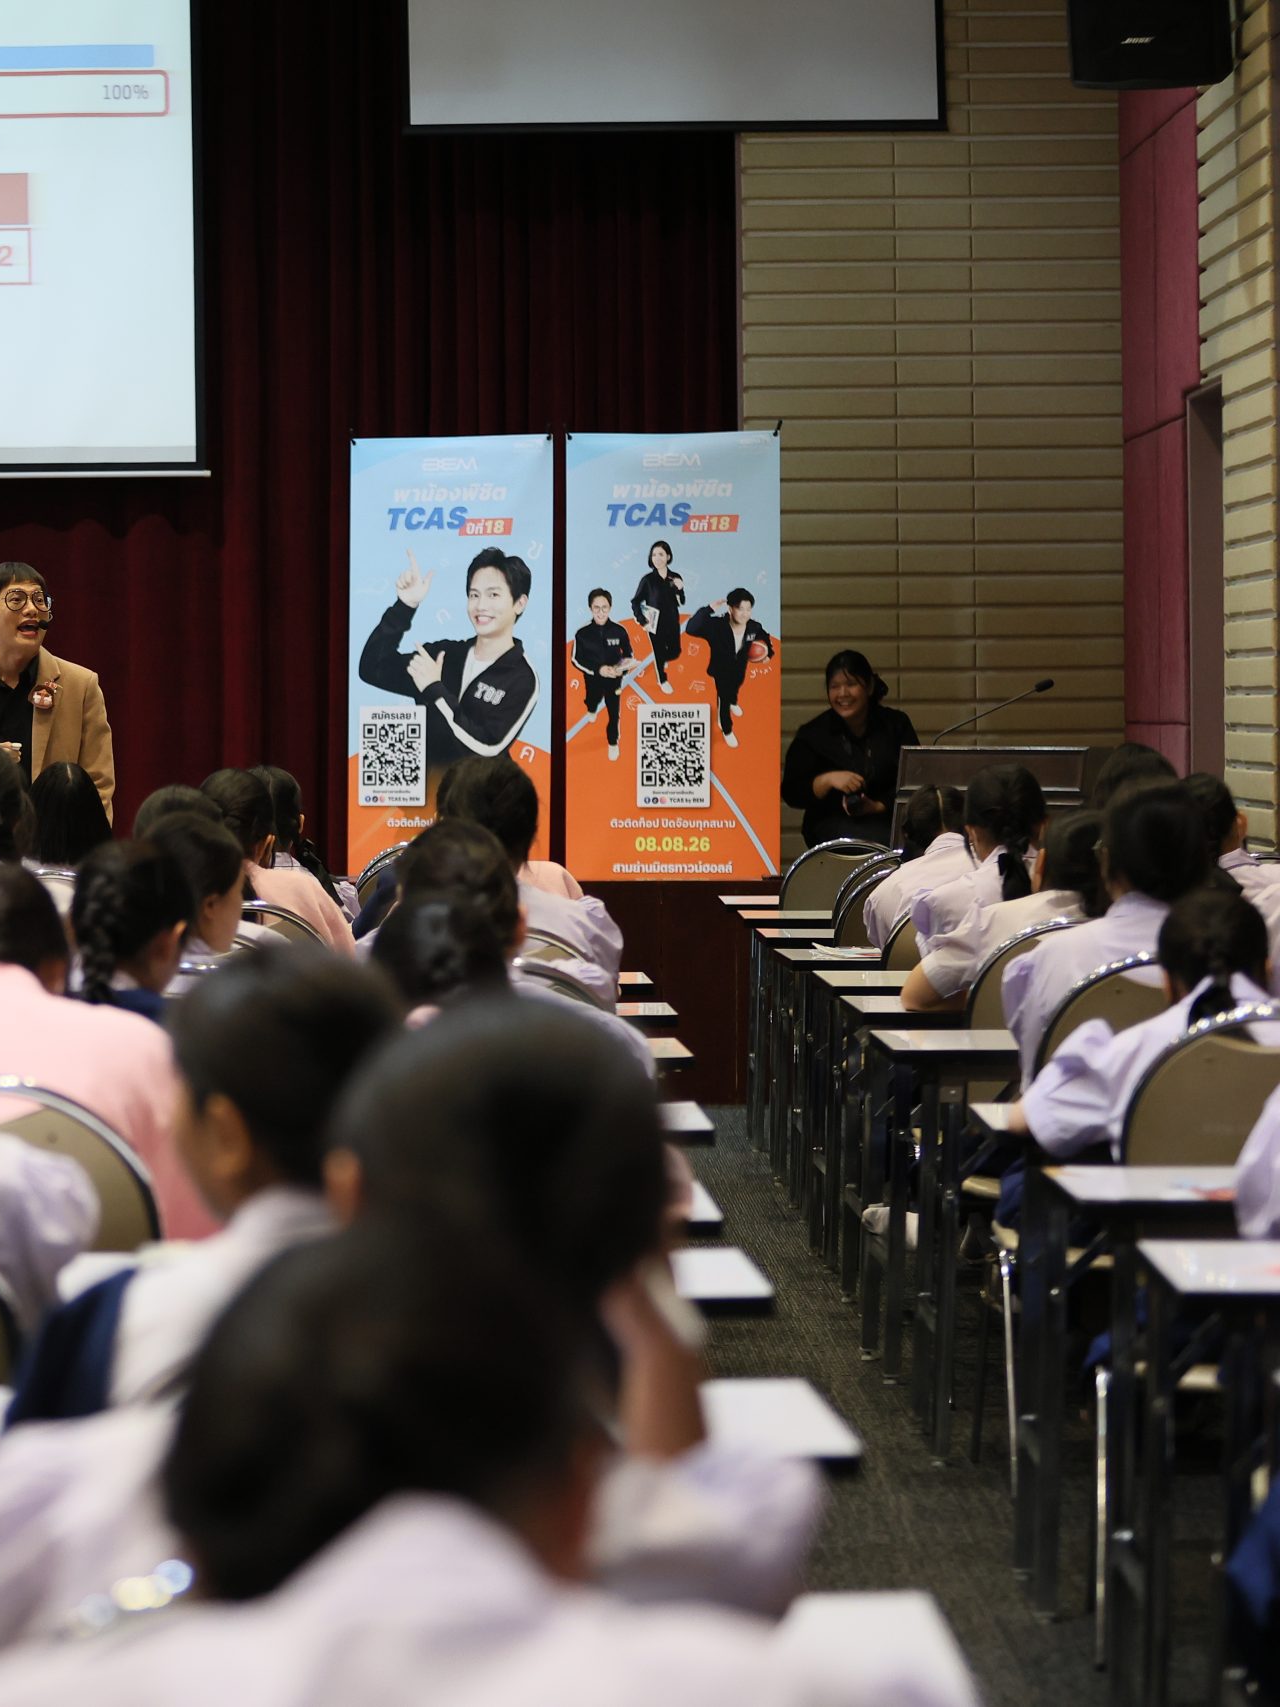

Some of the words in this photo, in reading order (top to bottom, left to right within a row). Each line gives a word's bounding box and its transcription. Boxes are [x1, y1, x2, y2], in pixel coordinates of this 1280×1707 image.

[102, 84, 150, 100] 100%
[642, 453, 702, 468] BEM
[393, 482, 509, 502] พาน้องพิชิต
[612, 478, 734, 499] พาน้องพิชิต
[387, 506, 469, 531] TCAS
[606, 502, 692, 527] TCAS
[473, 681, 506, 705] YOU
[371, 710, 412, 720] สมัครเลย
[650, 708, 695, 719] สมัครเลย
[610, 816, 660, 829] ติวติดท็อป
[661, 817, 737, 831] ปิดจ๊อบทุกสนาม
[635, 836, 711, 852] 08.08.26
[612, 860, 734, 874] สามย่านมิตรทาวน์ฮอลล์
